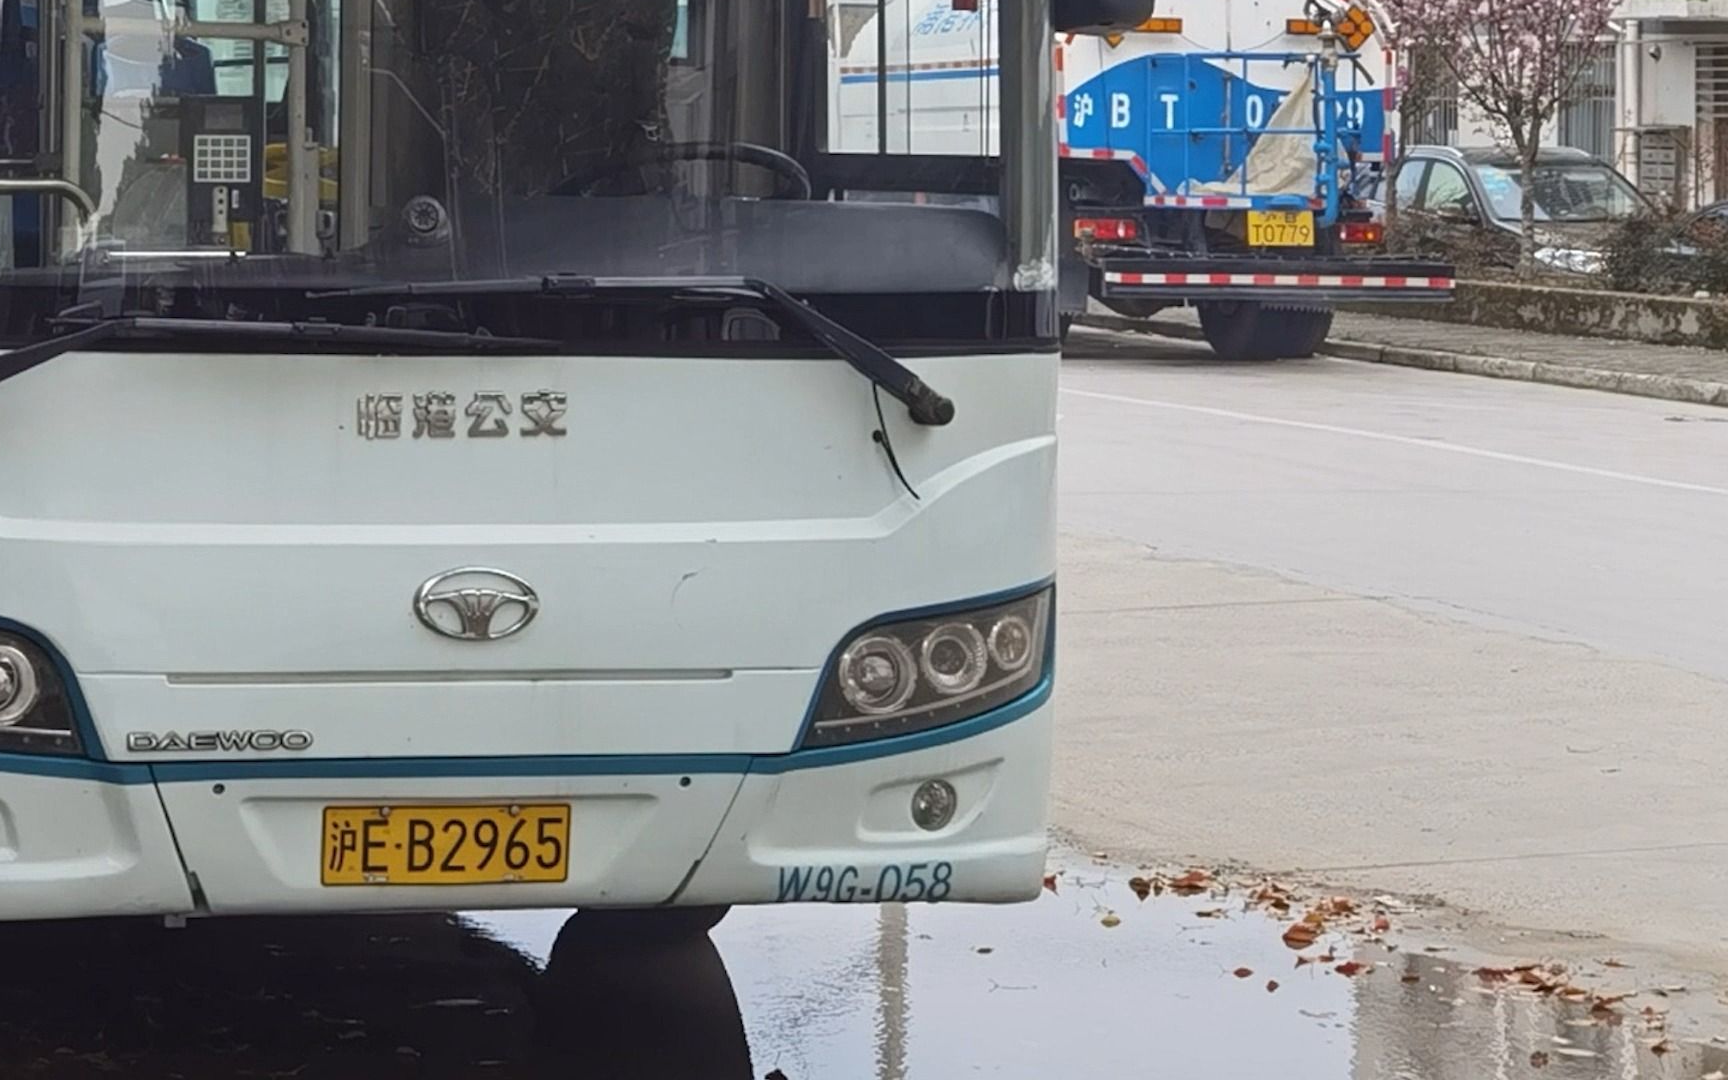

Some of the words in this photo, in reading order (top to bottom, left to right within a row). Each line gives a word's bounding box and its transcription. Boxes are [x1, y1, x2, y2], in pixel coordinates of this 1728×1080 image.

[1251, 223, 1311, 243] T0779
[357, 389, 569, 441] 临港公交
[126, 730, 314, 753] DAEWOO
[776, 861, 954, 904] W9G-058
